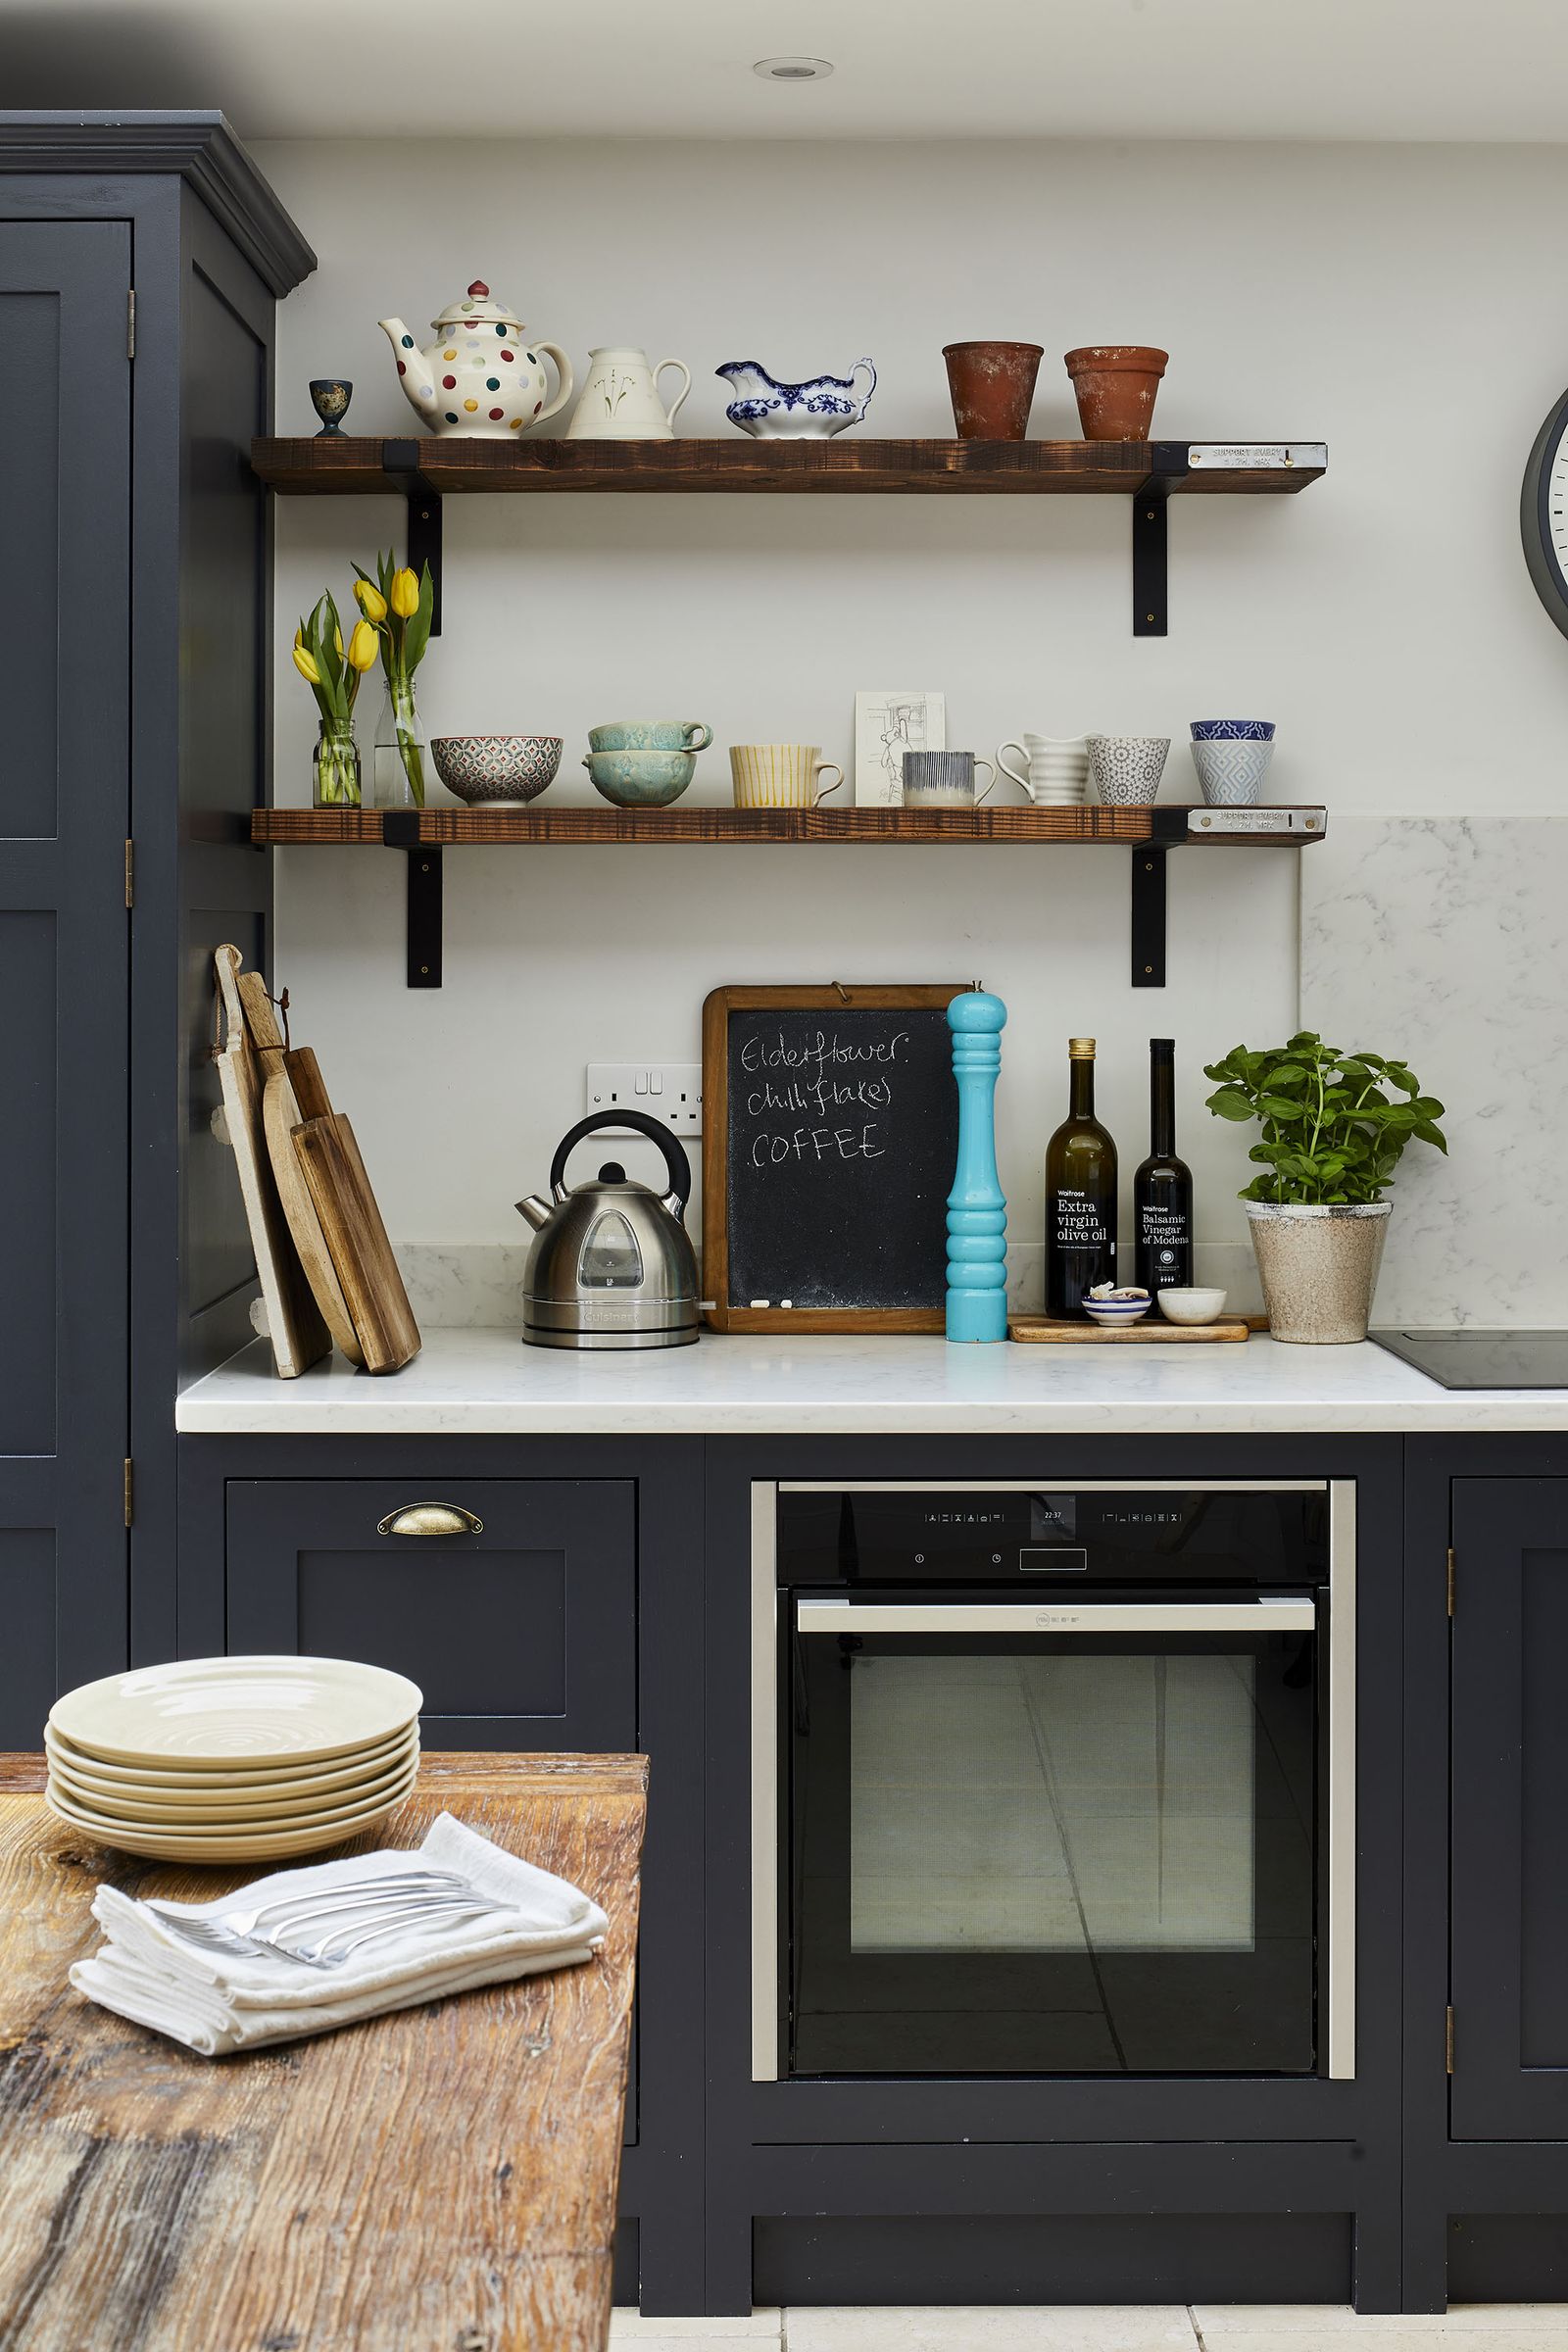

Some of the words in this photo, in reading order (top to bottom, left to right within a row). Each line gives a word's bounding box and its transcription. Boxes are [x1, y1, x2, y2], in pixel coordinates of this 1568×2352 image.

[752, 1124, 885, 1166] COFFEE
[1057, 1200, 1096, 1212] Extra
[1057, 1215, 1099, 1229] virgin
[1143, 1214, 1186, 1223] Balsamic
[1057, 1228, 1088, 1241] olive
[1092, 1228, 1106, 1241] oil
[1143, 1224, 1181, 1236] Vinegar
[1143, 1235, 1152, 1244] of
[1153, 1235, 1189, 1244] Modena
